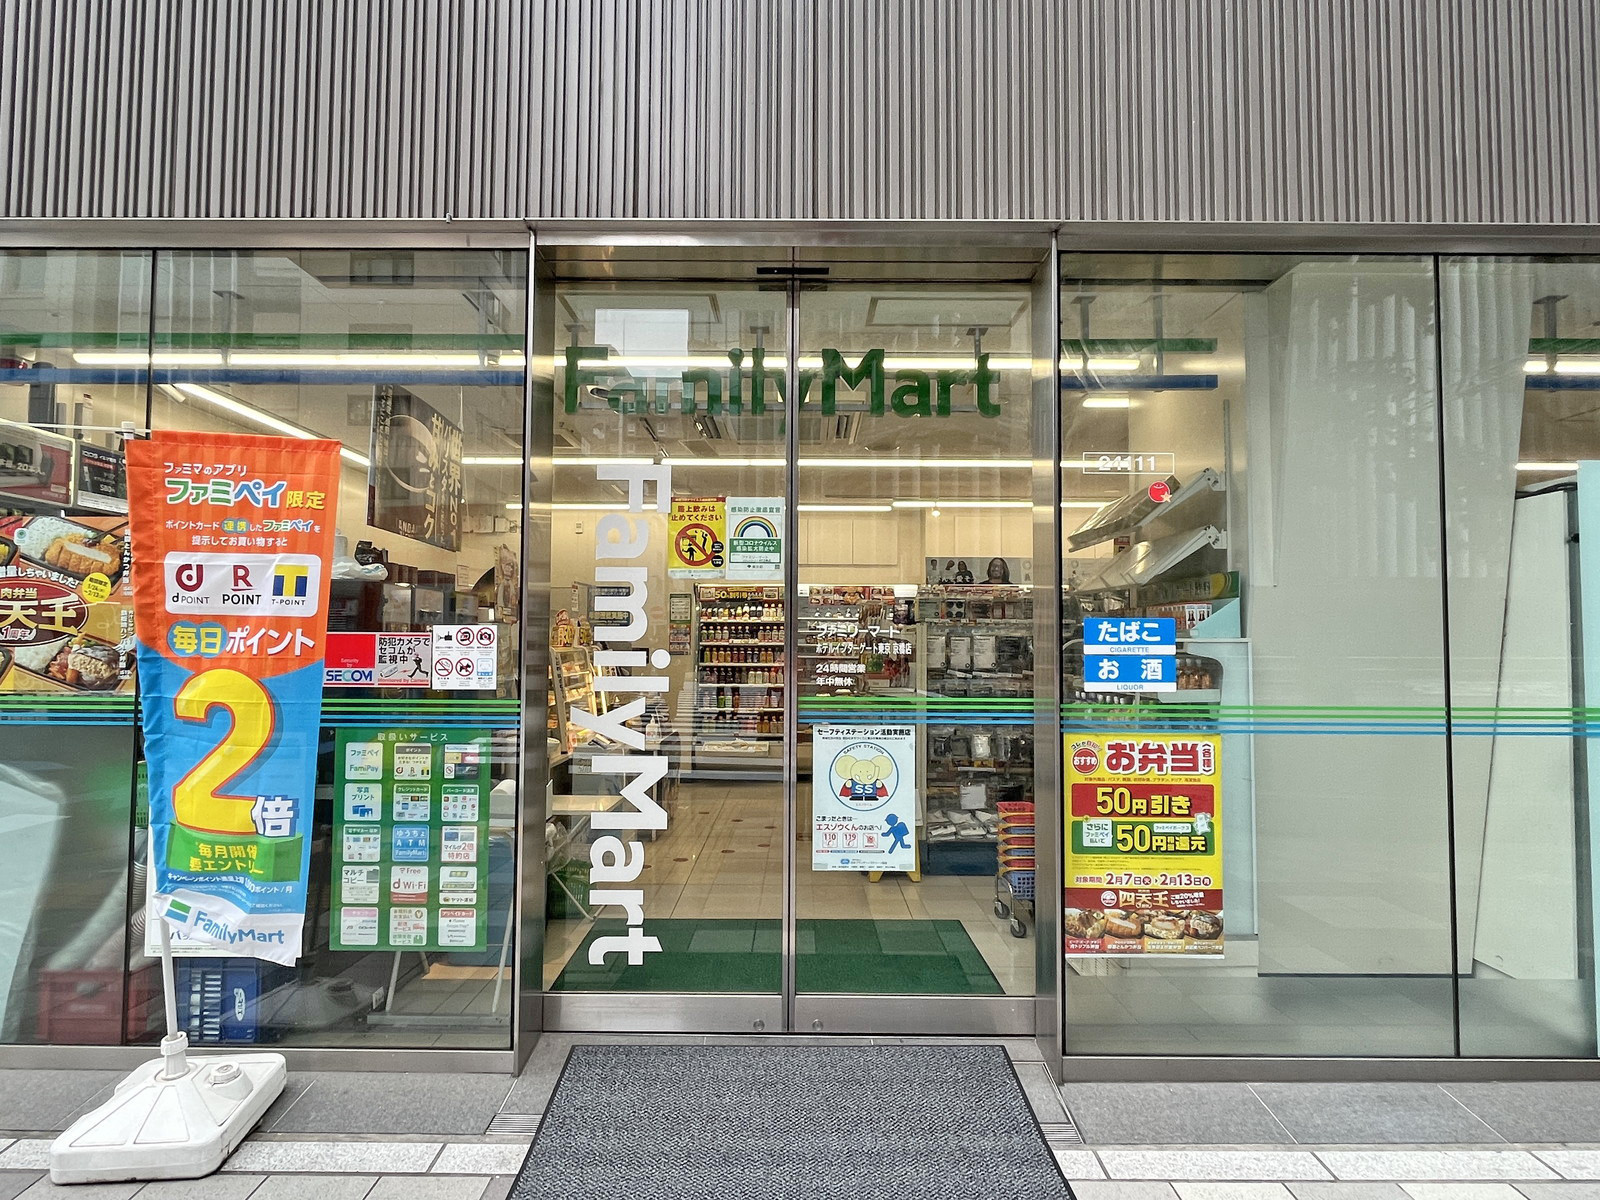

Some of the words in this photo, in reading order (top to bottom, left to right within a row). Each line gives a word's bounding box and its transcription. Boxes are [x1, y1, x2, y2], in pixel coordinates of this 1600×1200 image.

[1098, 455, 1155, 471] 24111
[163, 462, 247, 477] ファミマのアプリ
[671, 514, 723, 522] 止めてください
[191, 535, 288, 547] 提示してお買い物すると
[0, 587, 38, 599] 肉弁当
[181, 595, 210, 604] POINT
[222, 594, 262, 605] POINT
[271, 598, 306, 606] T-POINT
[816, 625, 901, 639] ファミリーマート
[1097, 621, 1161, 642] たばこ
[172, 625, 316, 657] 毎日ポイント
[378, 637, 431, 647] 防犯カメラで
[378, 645, 416, 655] セコムが
[1109, 645, 1150, 653] CIGARETTE
[378, 654, 409, 664] 監視中
[815, 663, 866, 674] 24時間営業
[325, 669, 373, 682] SECOM
[815, 676, 855, 687] 年中無休
[1116, 683, 1144, 691] LIQUOR
[571, 464, 672, 965] FamilyMart
[1106, 742, 1200, 773] お弁当
[349, 764, 379, 773] FamiPay
[1096, 787, 1192, 815] 50円引き
[1086, 823, 1109, 831] さらに
[194, 911, 285, 944] FamilyMart
